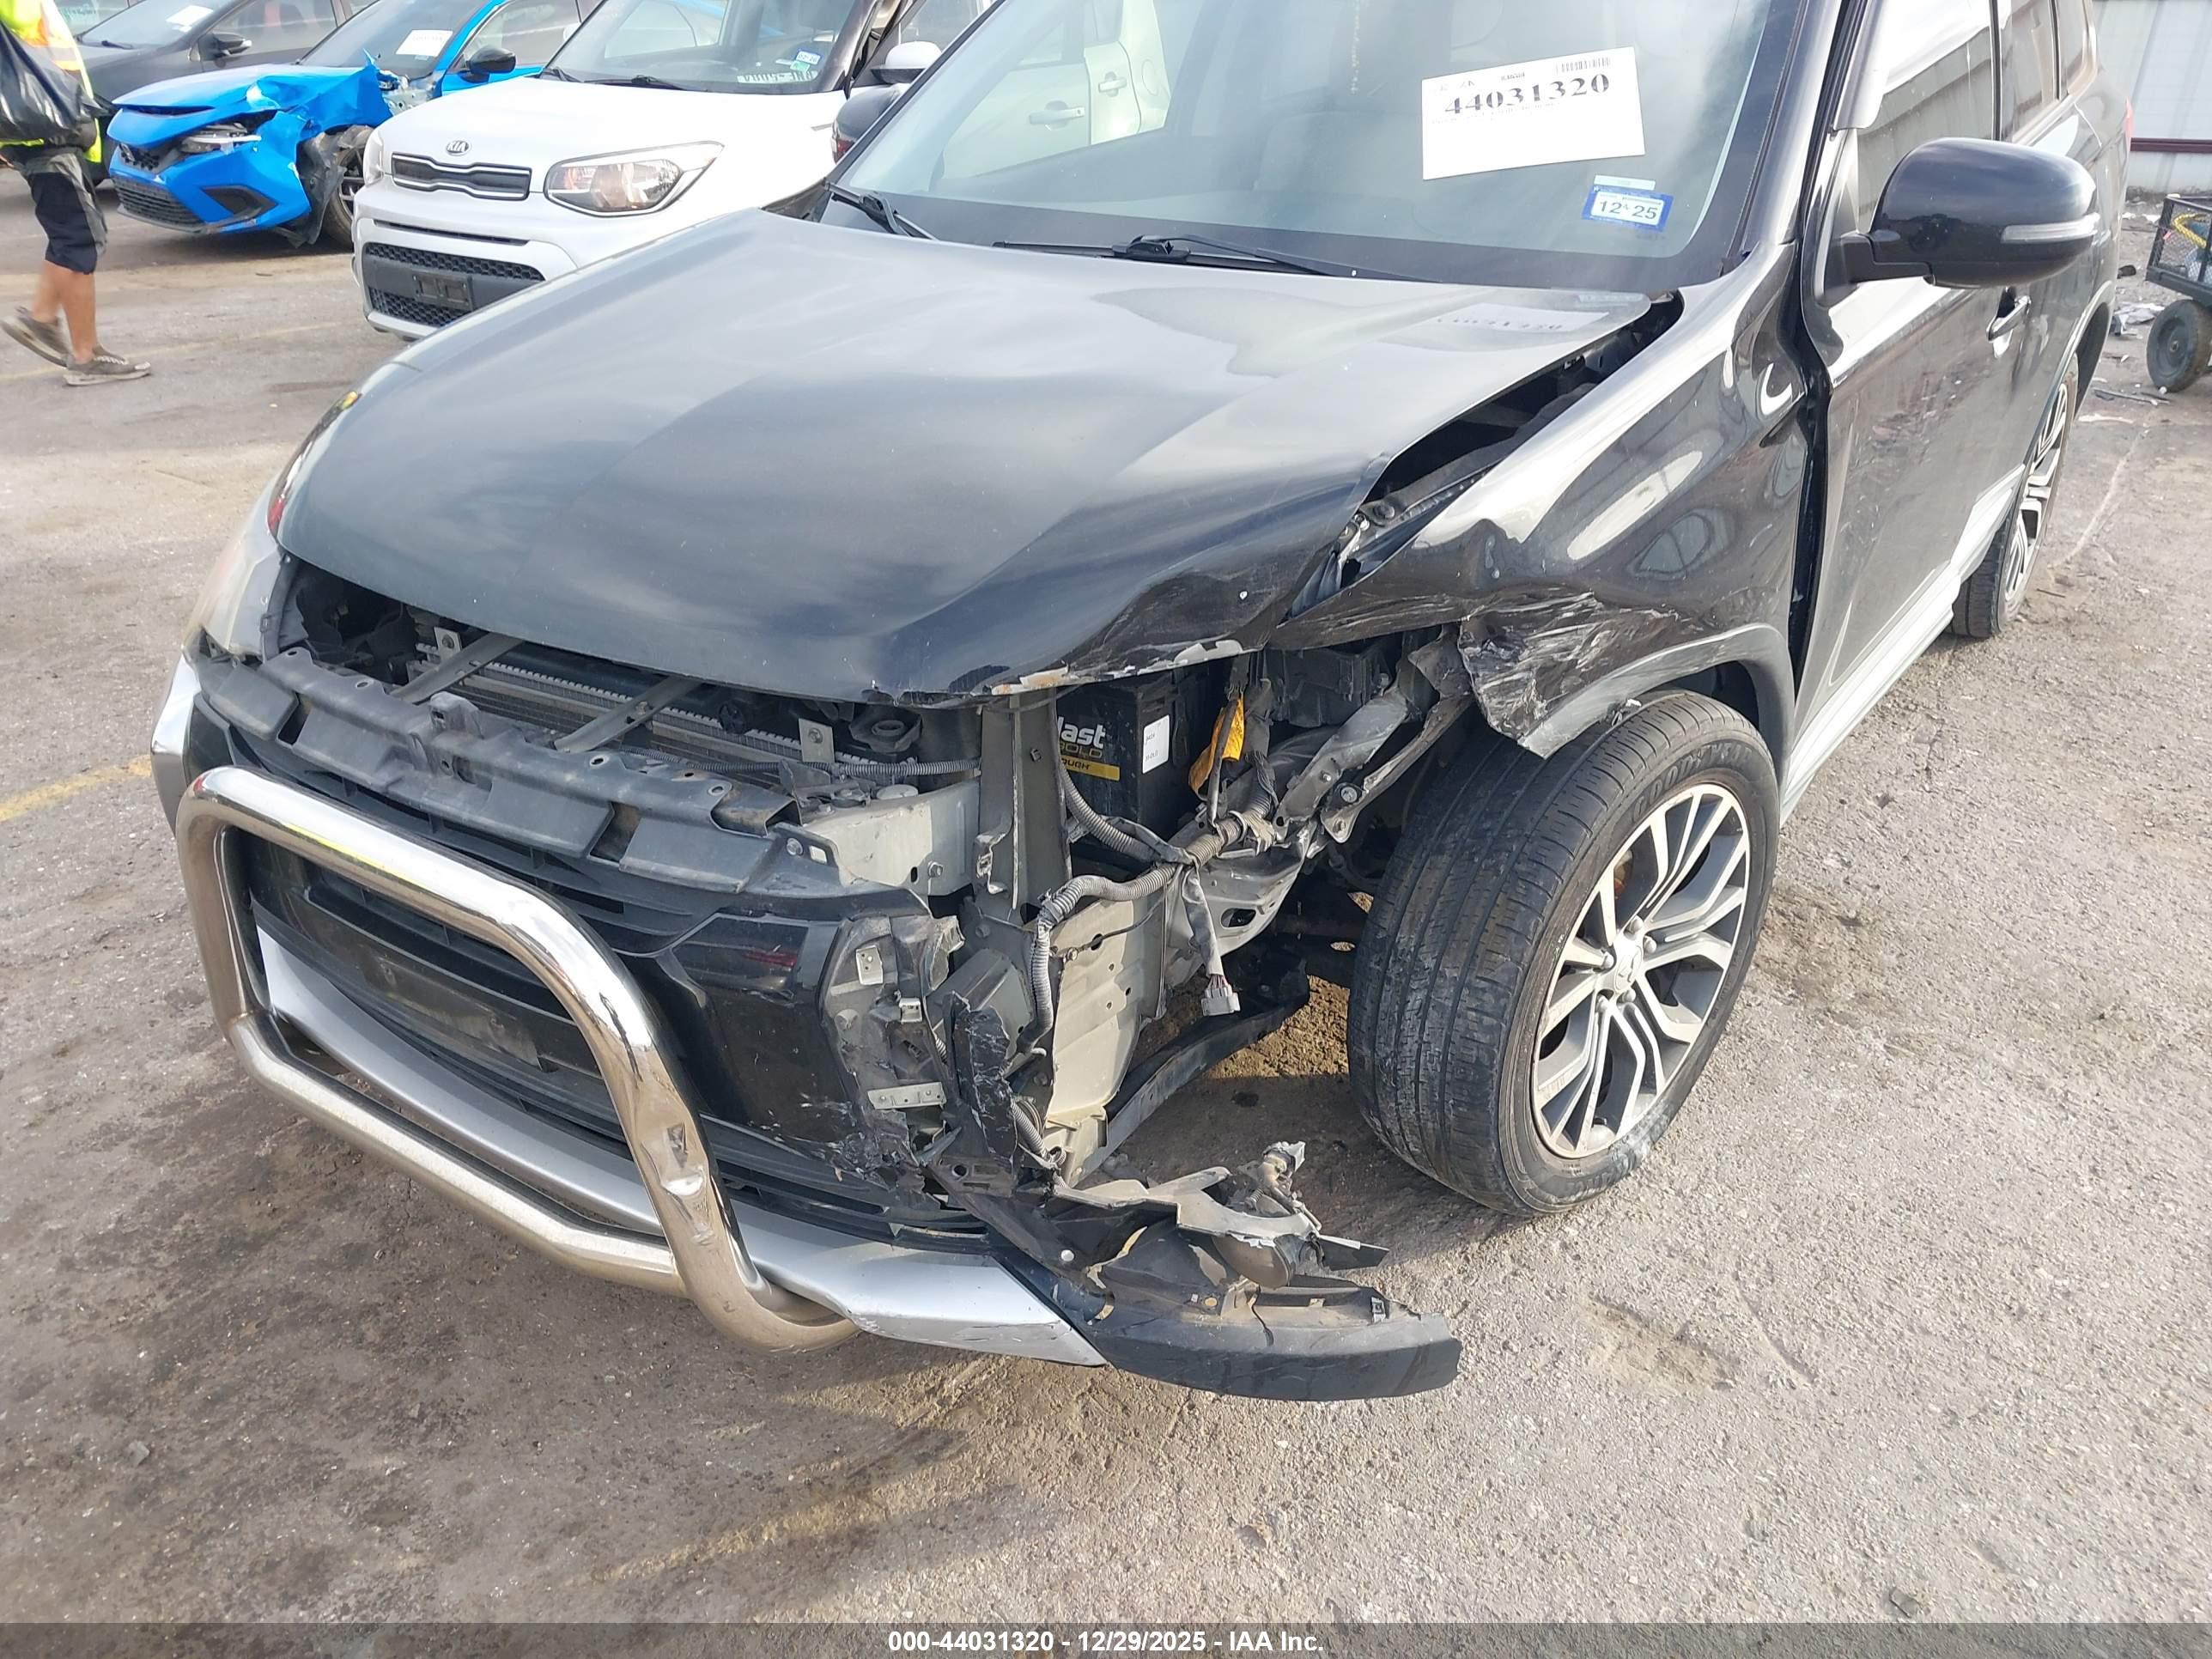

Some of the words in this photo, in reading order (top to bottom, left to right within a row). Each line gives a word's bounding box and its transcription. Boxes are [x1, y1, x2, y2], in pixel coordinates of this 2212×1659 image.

[1444, 73, 1610, 114] 44031320
[447, 140, 469, 153] KIA
[1600, 200, 1622, 215] 12
[1632, 204, 1658, 220] 25
[1633, 740, 1753, 822] GOODYEAR
